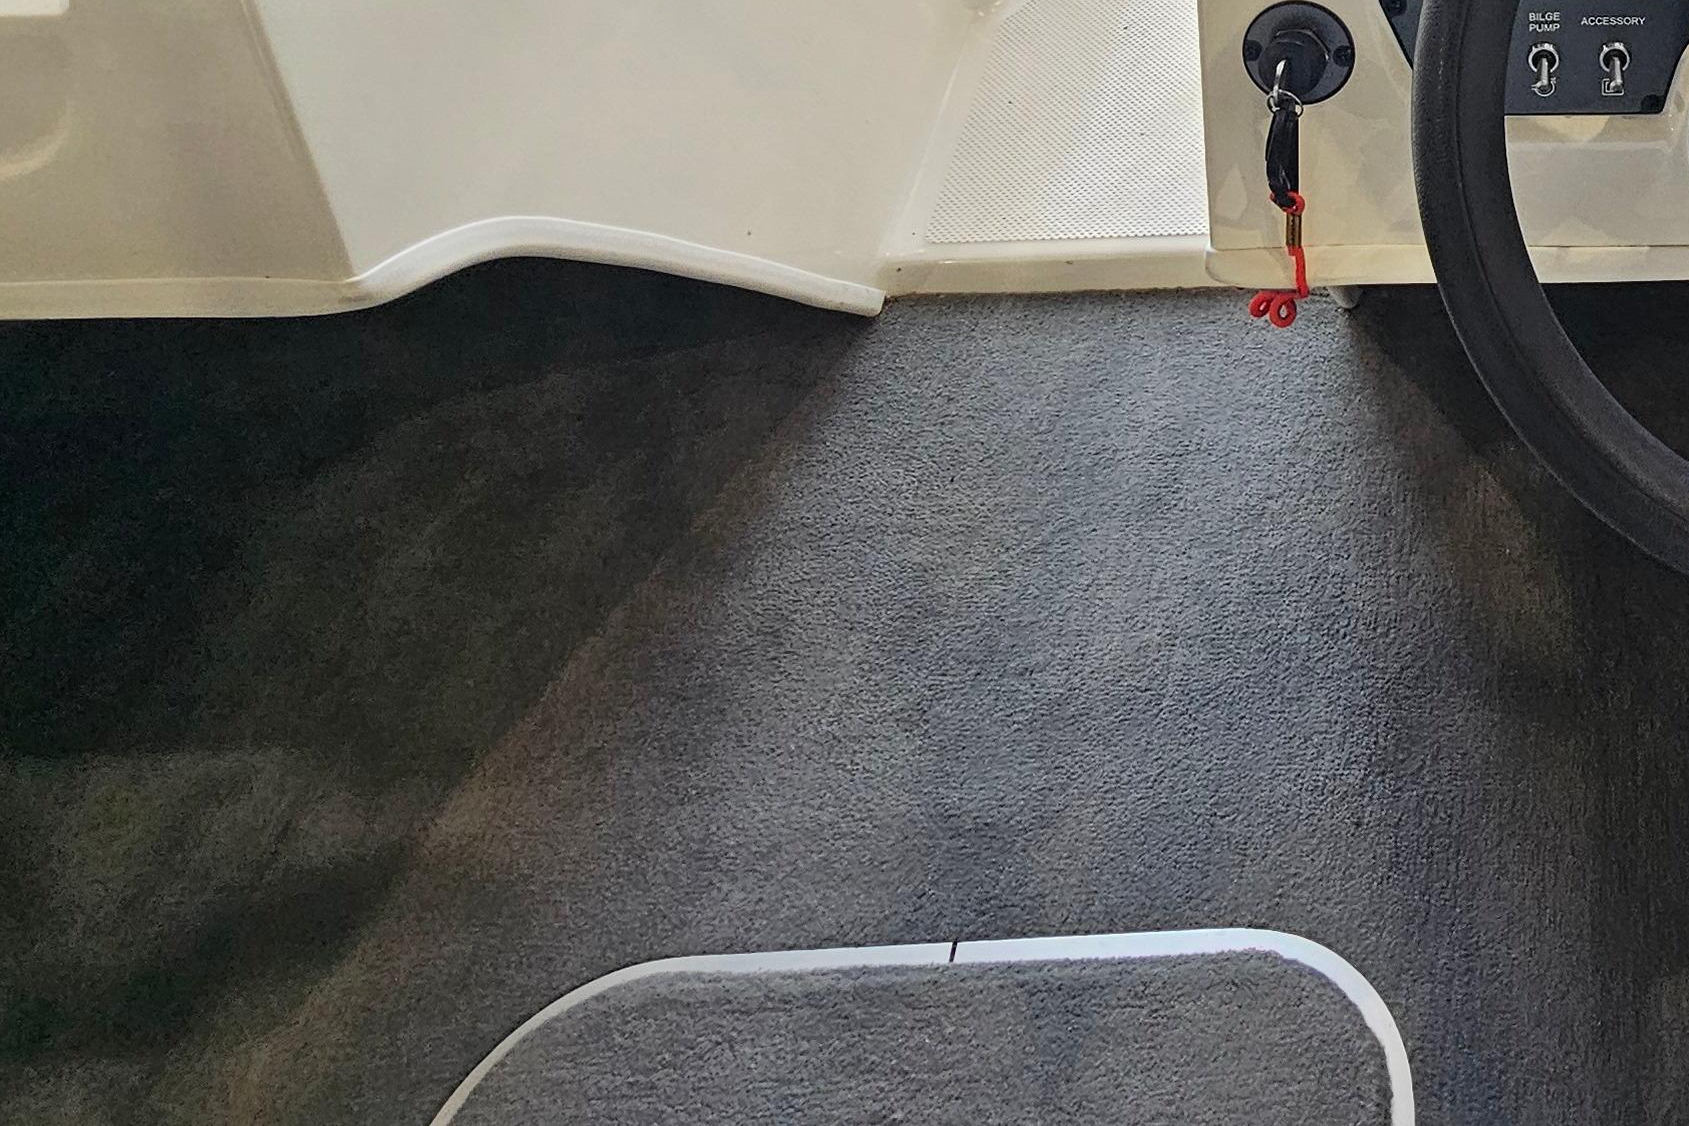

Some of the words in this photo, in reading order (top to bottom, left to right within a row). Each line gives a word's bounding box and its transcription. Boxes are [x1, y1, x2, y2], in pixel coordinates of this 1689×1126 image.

[1528, 12, 1560, 22] BILGE
[1580, 16, 1646, 27] ACCESSORY
[1528, 23, 1560, 33] PUMP
